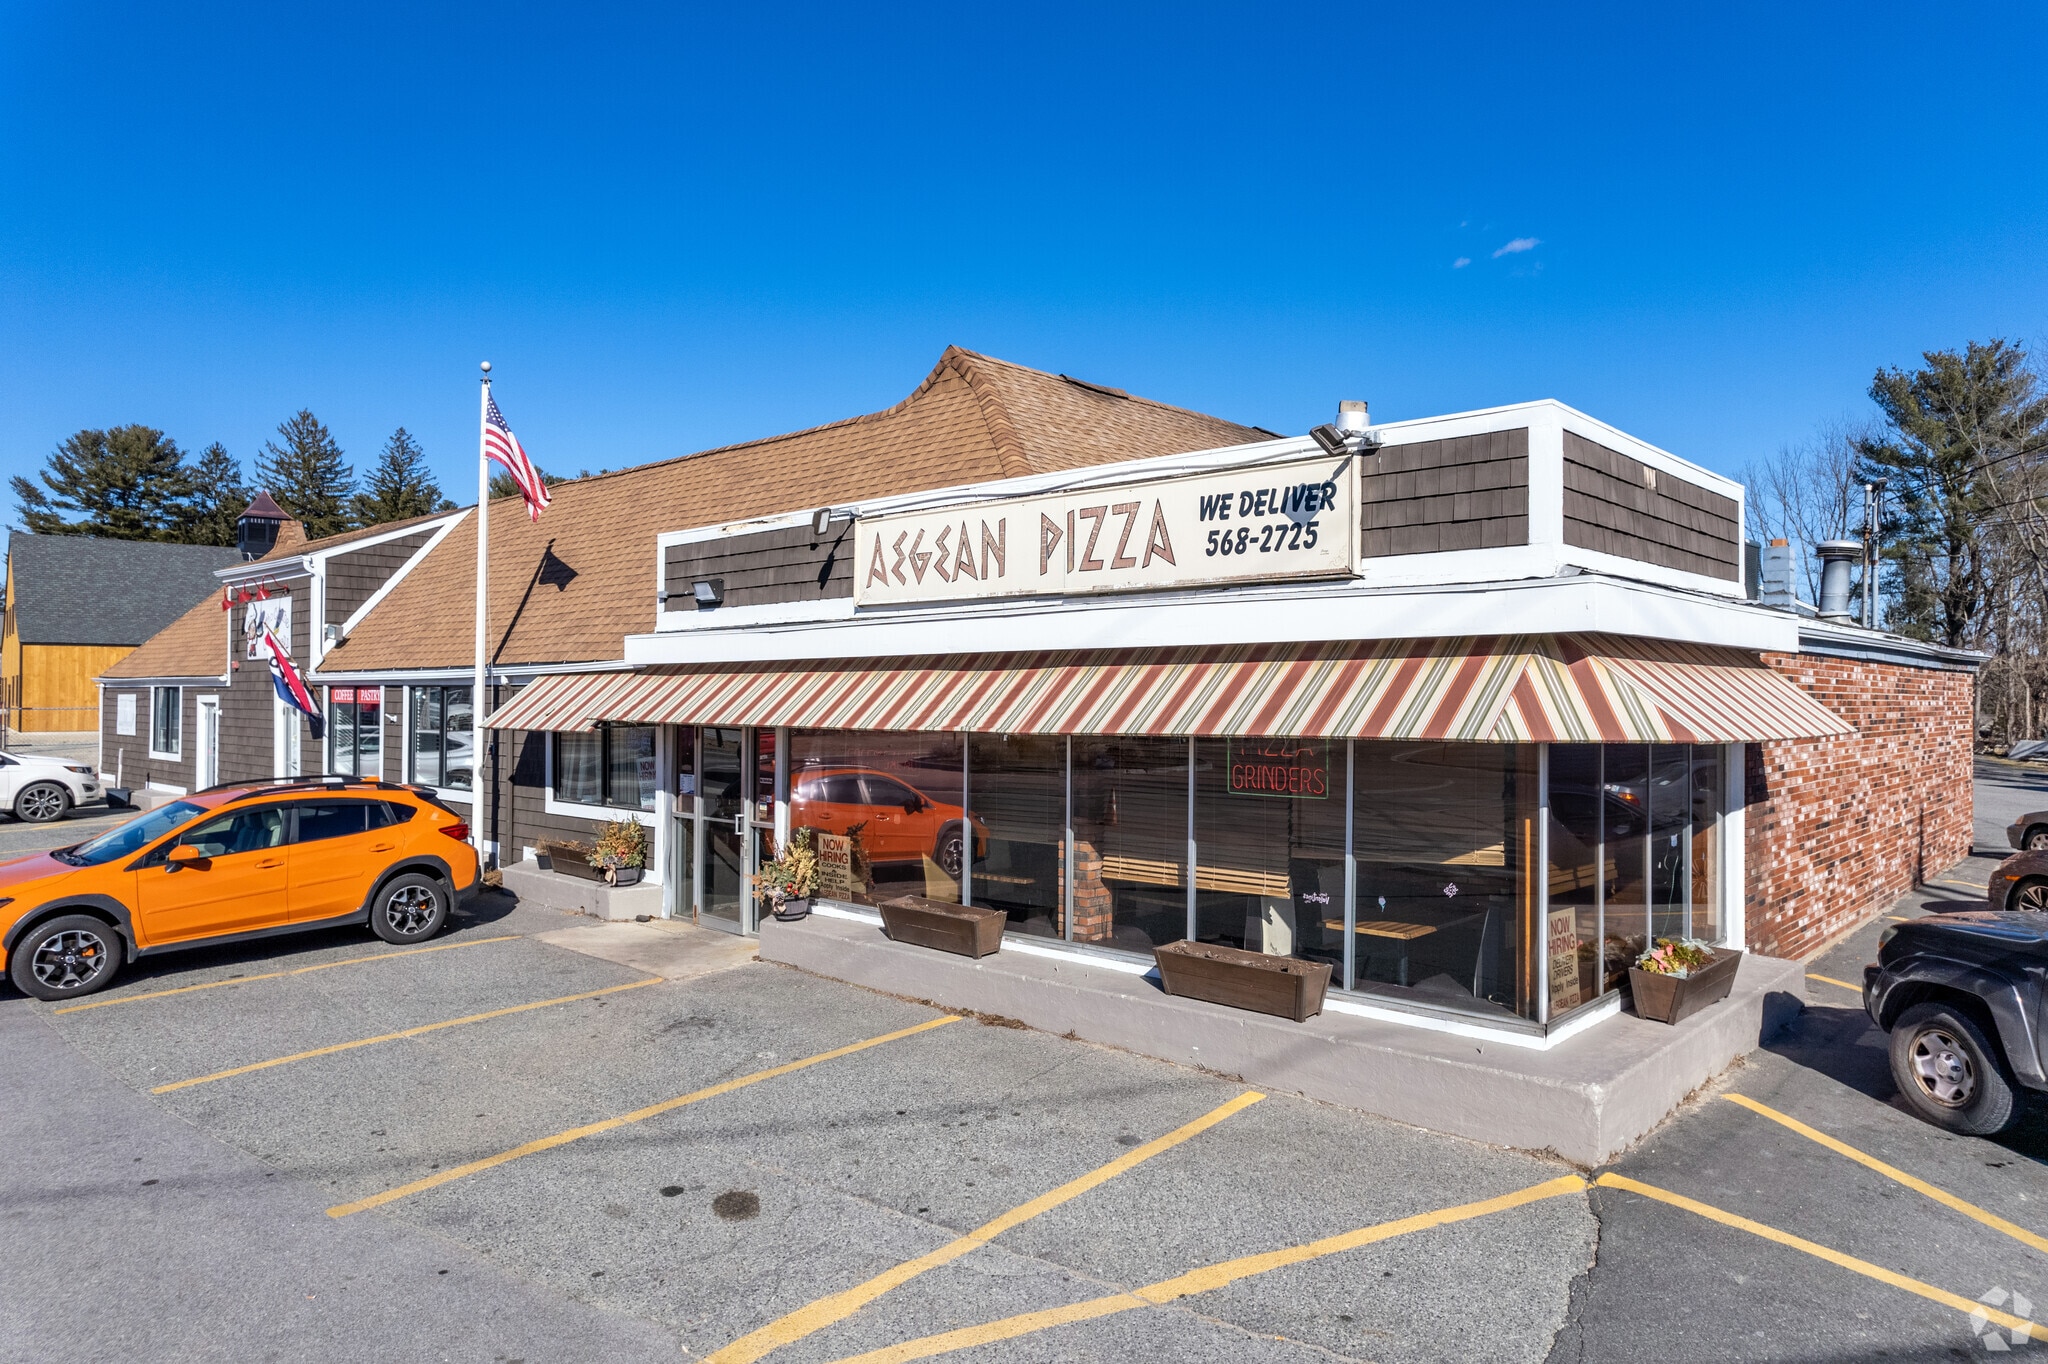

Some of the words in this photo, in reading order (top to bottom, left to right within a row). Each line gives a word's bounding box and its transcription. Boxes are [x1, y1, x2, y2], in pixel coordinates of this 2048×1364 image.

[1199, 493, 1234, 521] WE
[1239, 481, 1337, 517] DELIVER
[866, 517, 1006, 589] AEGEAN
[1040, 498, 1176, 576] PIZZA
[1205, 520, 1319, 557] 568-2725
[334, 689, 354, 701] COFFEE
[360, 689, 381, 701] PASTRY
[639, 759, 656, 771] NOW
[1232, 764, 1325, 794] GRINDERS
[823, 839, 843, 851] NOW
[820, 850, 849, 864] HIRING
[822, 862, 847, 870] COOKS
[821, 871, 848, 879] INSIDE
[1550, 915, 1570, 937] NOW
[1548, 932, 1575, 957] HIRING
[1553, 964, 1574, 980] DRIVERS
[1566, 976, 1579, 988] Inside
